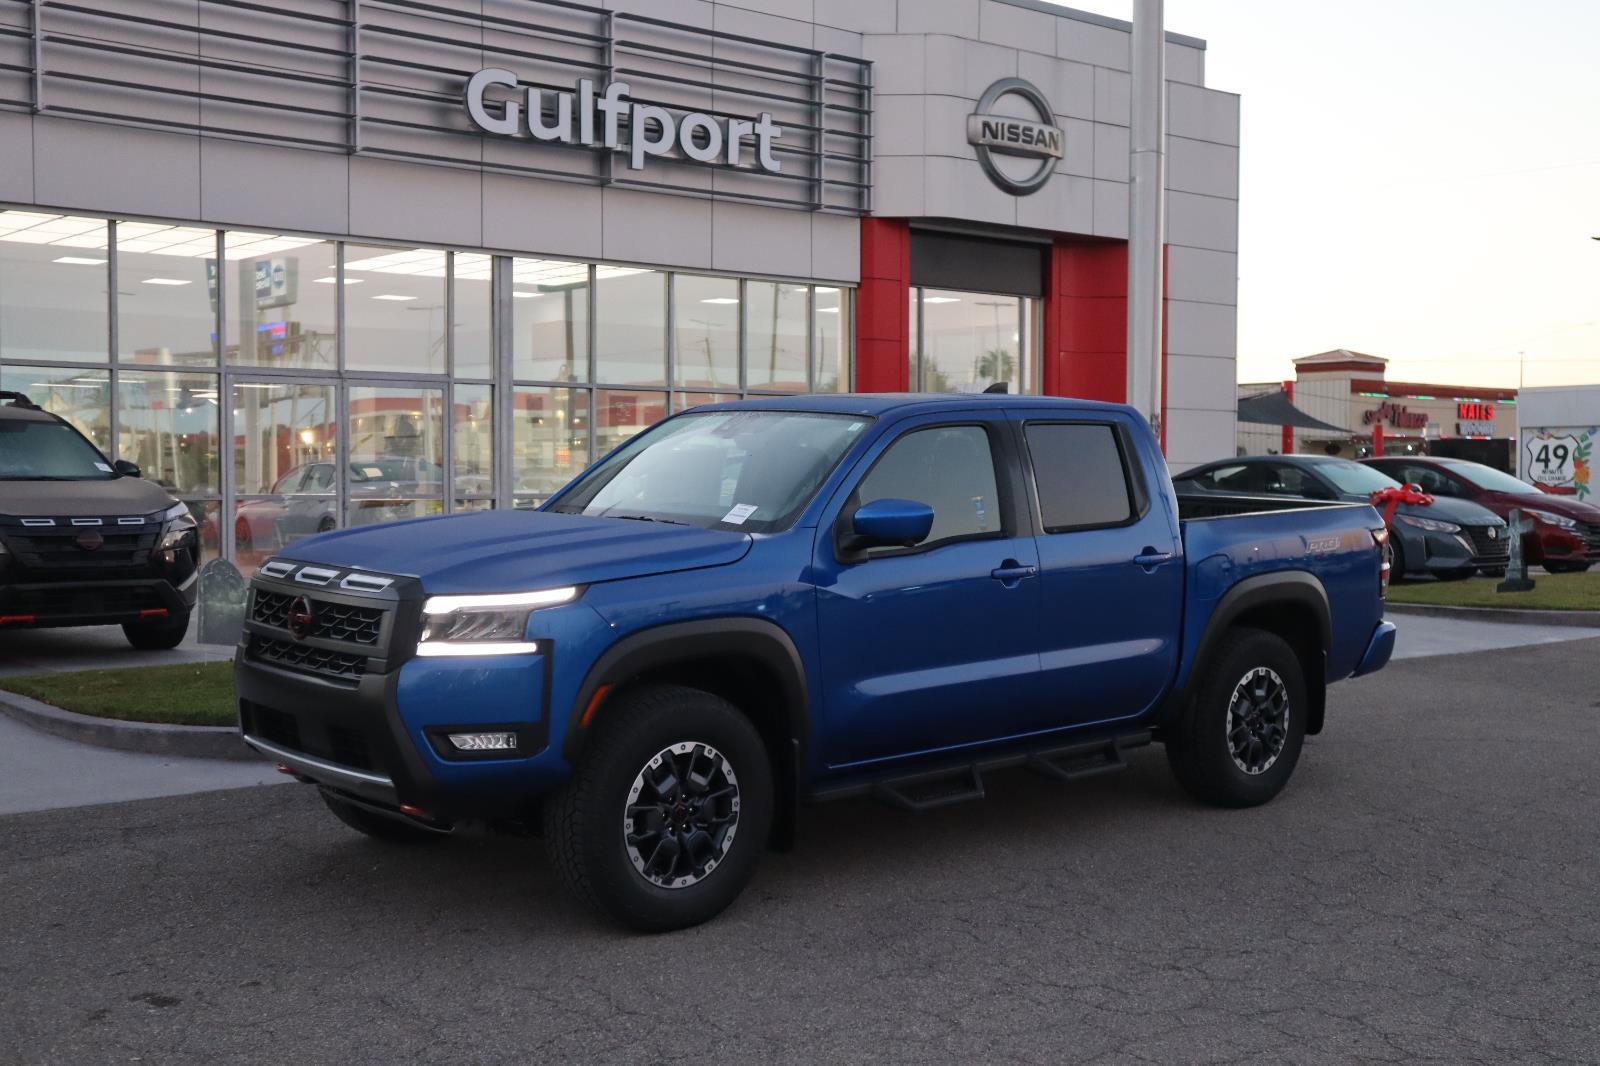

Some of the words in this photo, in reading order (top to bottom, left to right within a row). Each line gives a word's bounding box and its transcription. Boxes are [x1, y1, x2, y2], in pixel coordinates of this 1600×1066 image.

[464, 67, 783, 173] Gulfport
[981, 120, 1060, 151] NISSAN
[1458, 403, 1494, 420] NAILS
[1535, 444, 1569, 470] 49
